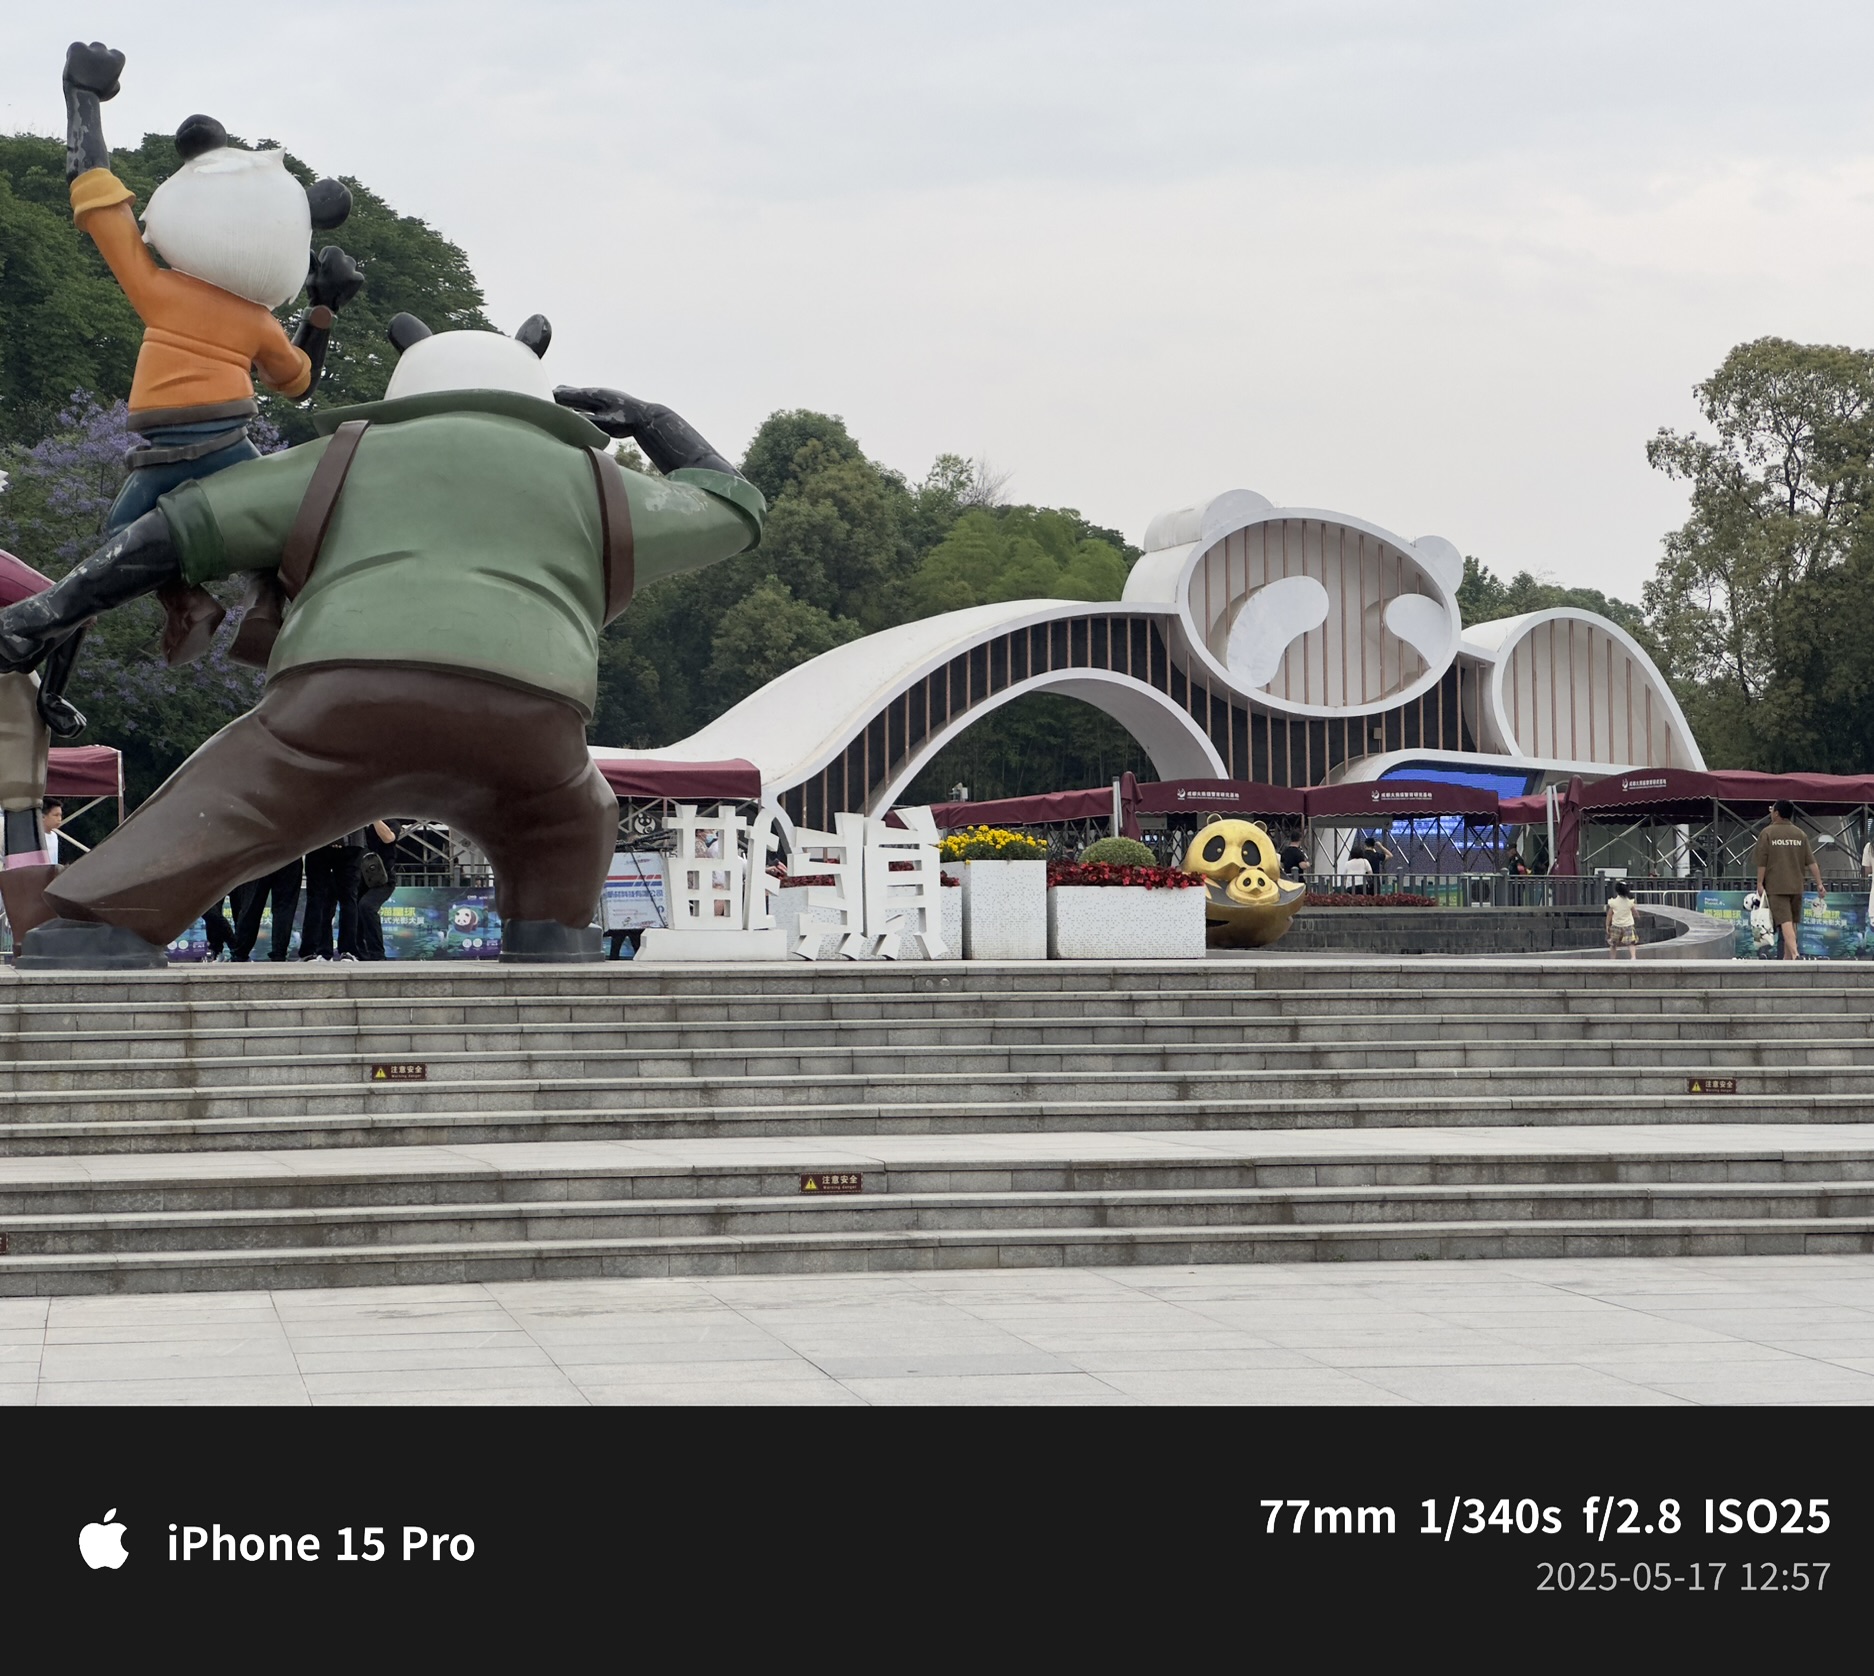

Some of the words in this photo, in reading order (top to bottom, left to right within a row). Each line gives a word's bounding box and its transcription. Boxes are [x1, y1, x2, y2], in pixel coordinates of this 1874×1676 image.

[1705, 1080, 1733, 1088] 注意安全
[822, 1175, 857, 1184] 注意安全
